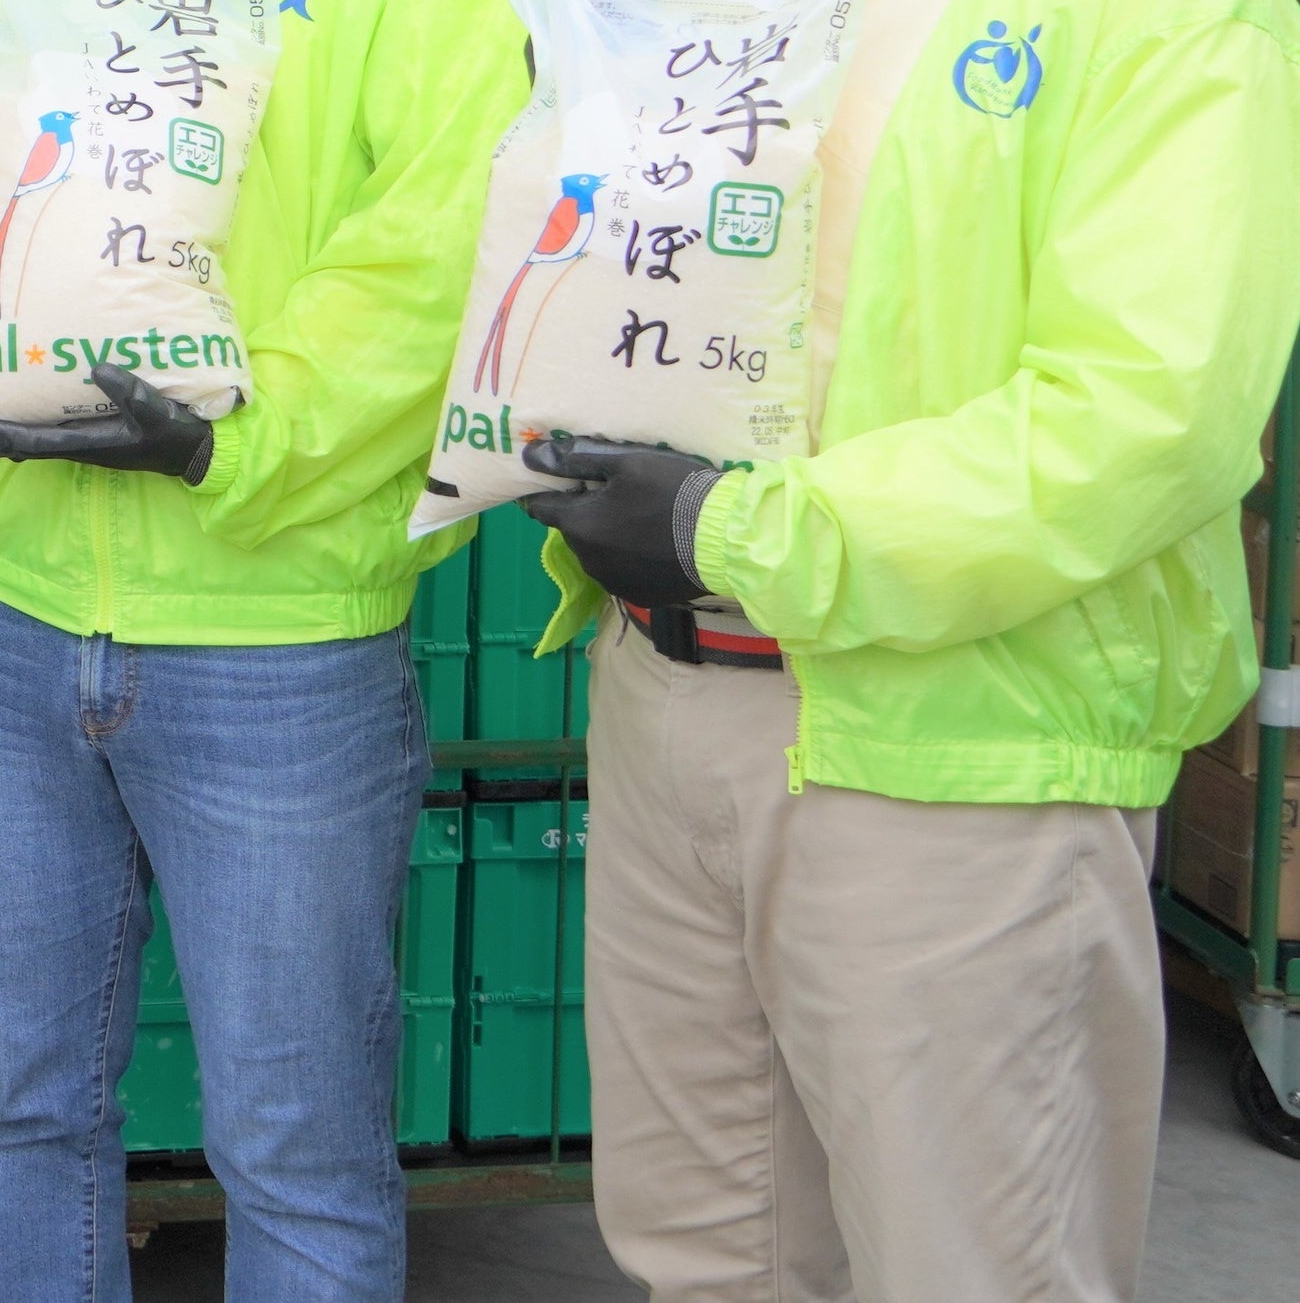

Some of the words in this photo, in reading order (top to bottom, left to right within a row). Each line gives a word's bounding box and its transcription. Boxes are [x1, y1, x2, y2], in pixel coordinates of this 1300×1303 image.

[175, 144, 219, 166] チャレンジ
[178, 126, 218, 150] エコ
[611, 38, 722, 369] ひとめぼれ
[720, 193, 773, 218] エコ
[716, 217, 775, 236] チャレンジ
[168, 240, 211, 284] 5kg
[699, 334, 768, 383] 5kg
[441, 401, 513, 455] pal
